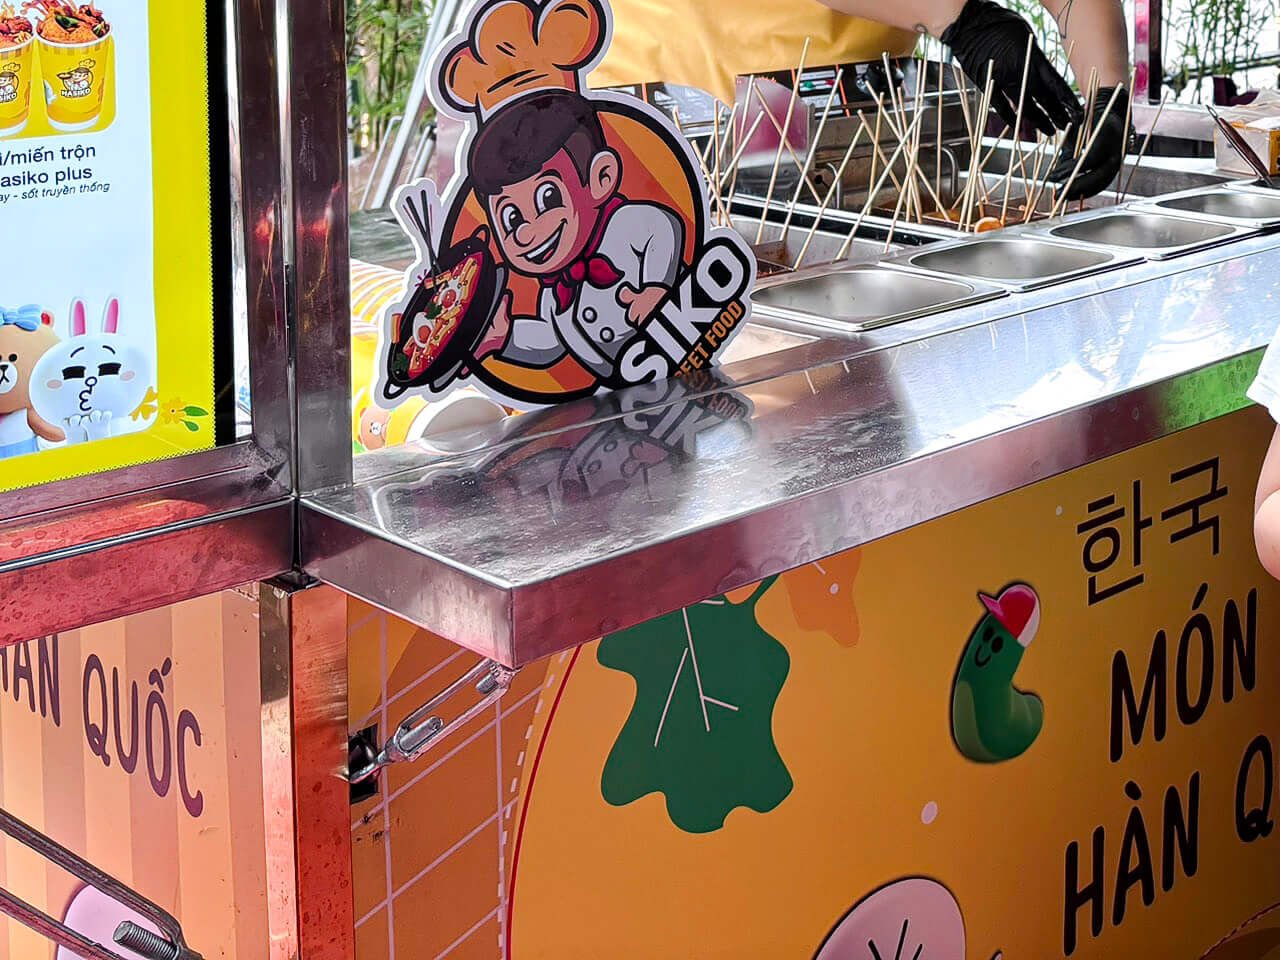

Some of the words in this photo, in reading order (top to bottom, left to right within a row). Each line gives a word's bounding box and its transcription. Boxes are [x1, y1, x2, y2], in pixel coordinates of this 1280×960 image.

[0, 171, 49, 187] asiko
[55, 167, 93, 185] plus
[60, 144, 96, 161] trộn
[621, 245, 744, 382] SIKO
[705, 301, 743, 347] FOOD
[1077, 456, 1228, 606] 한국
[83, 654, 203, 818] QUỐC
[1110, 582, 1257, 763] MÓN
[1064, 771, 1200, 957] HÀN
